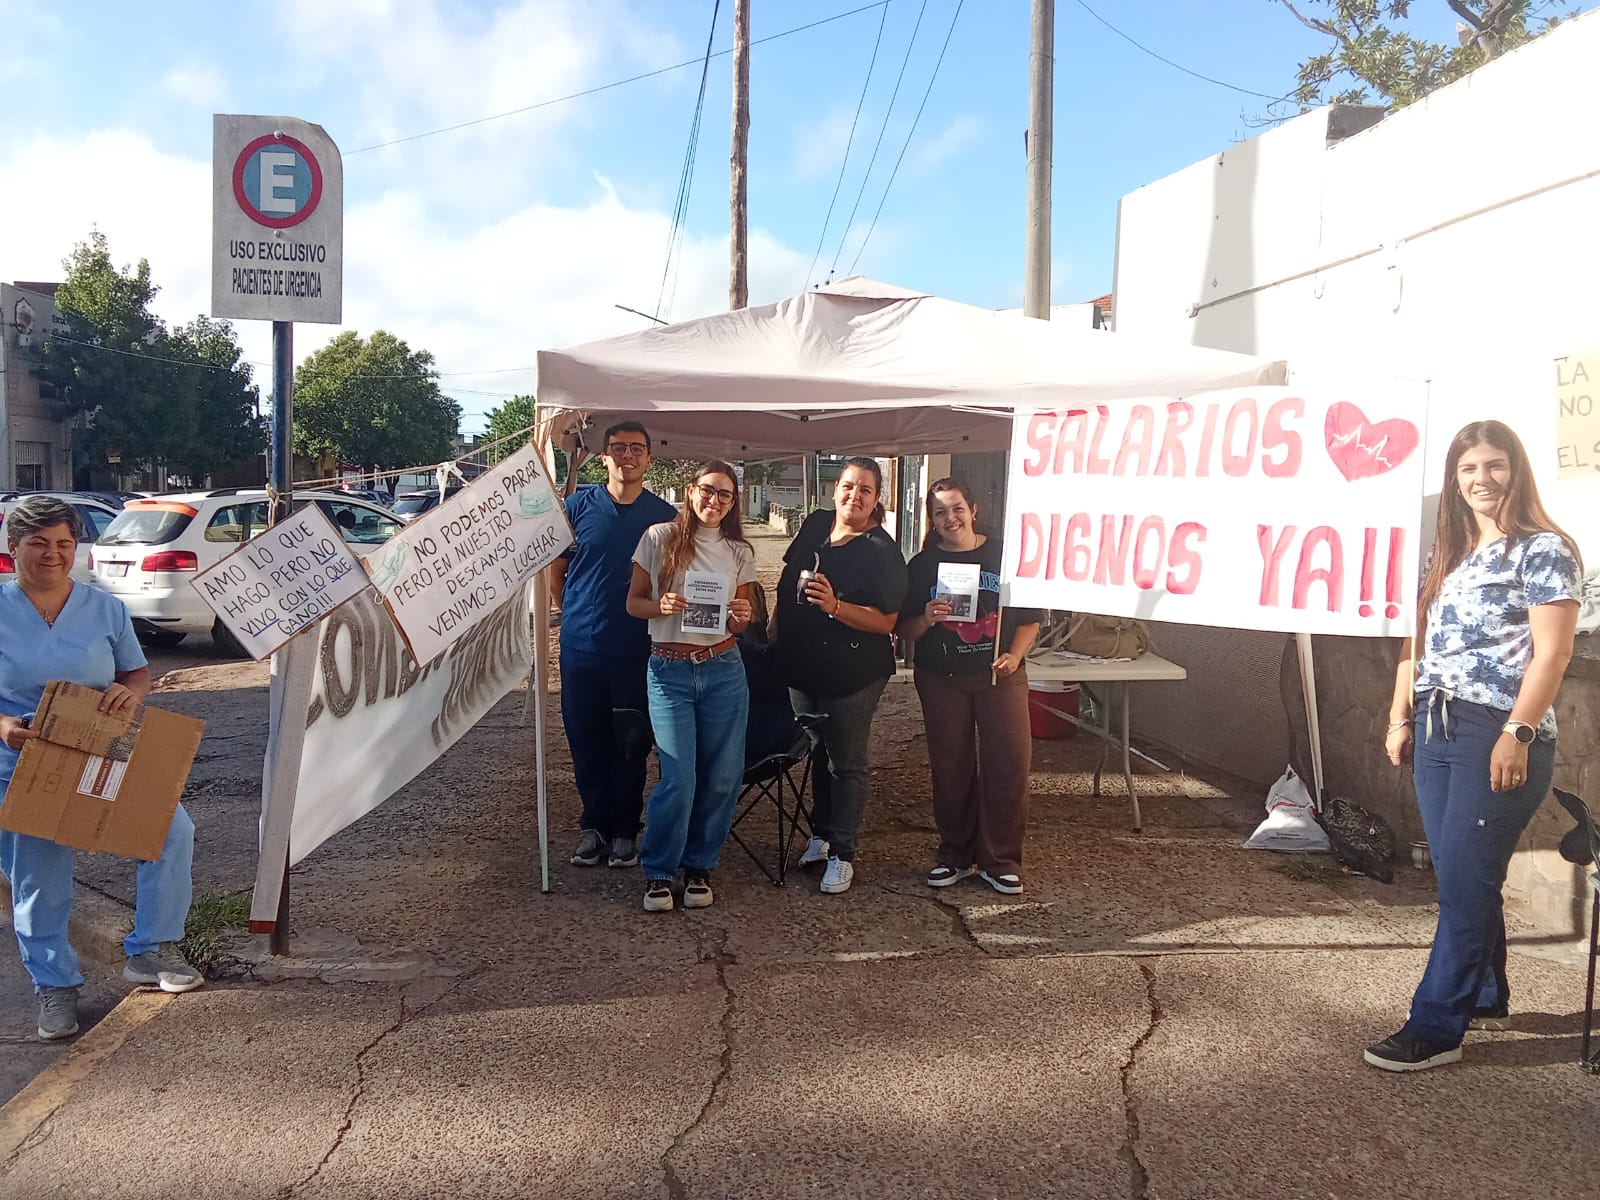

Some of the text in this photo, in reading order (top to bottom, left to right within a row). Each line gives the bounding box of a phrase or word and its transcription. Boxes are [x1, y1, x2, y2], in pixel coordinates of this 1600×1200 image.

[260, 152, 296, 213] E
[230, 240, 326, 263] USO EXCLUSIVO
[232, 268, 322, 298] PACIENTES DE URGENCIA
[1556, 361, 1590, 386] LA
[1559, 394, 1593, 418] NO
[1023, 397, 1305, 478] SALARIOS
[1557, 445, 1589, 468] EL
[414, 459, 541, 564] NO PODEMOS PARAR
[204, 520, 314, 601] AMO LO QUE
[223, 538, 336, 619] HAGO PERO NO
[393, 509, 513, 606] PERO EN NUESTRO
[428, 525, 560, 637] VENIMOS A LUCHAR
[446, 537, 516, 595] DESCANSO
[1015, 511, 1406, 620] DIGNOS YA!!
[240, 557, 351, 636] VIVO CON LO QUE
[277, 592, 336, 636] GANO!!!
